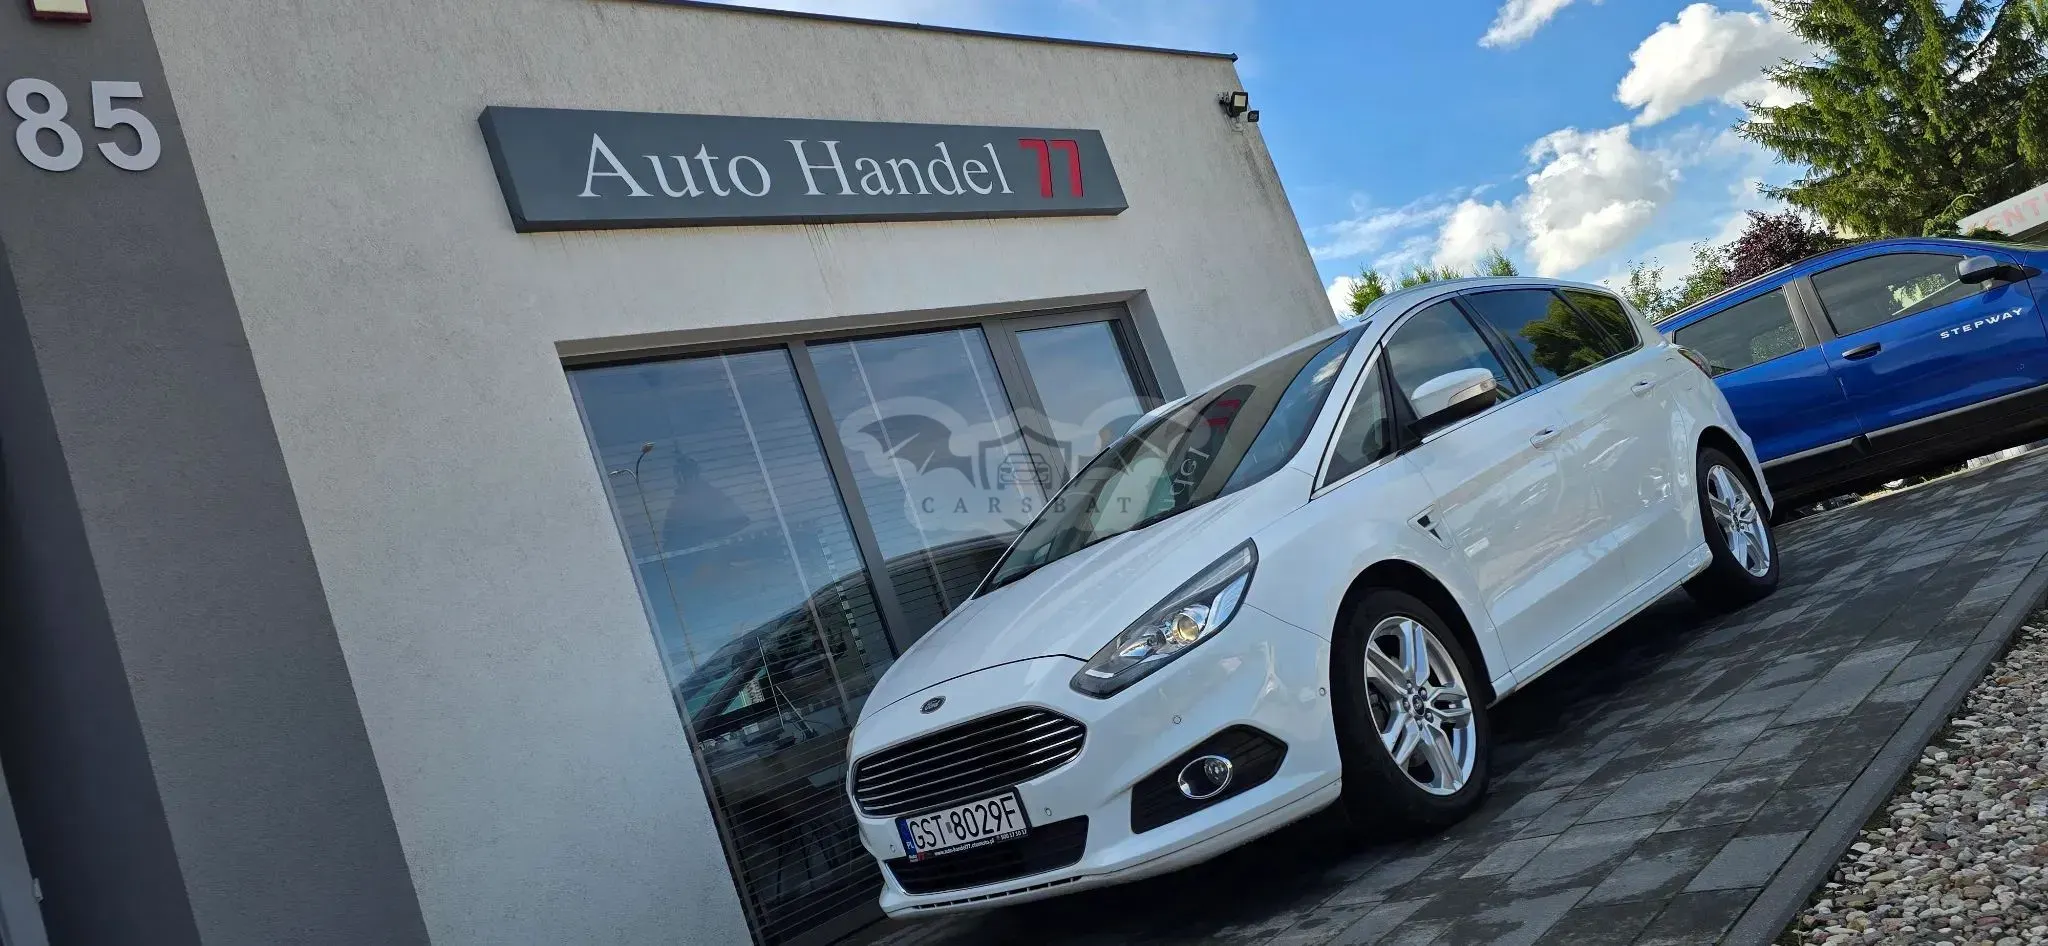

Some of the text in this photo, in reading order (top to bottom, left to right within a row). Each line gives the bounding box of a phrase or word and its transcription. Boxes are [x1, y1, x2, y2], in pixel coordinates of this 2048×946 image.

[6, 78, 161, 172] 85
[577, 133, 1084, 199] Auto Handel 77
[1940, 307, 2023, 339] STEPWAY
[906, 841, 915, 850] PL
[909, 795, 1016, 850] GST 8029F
